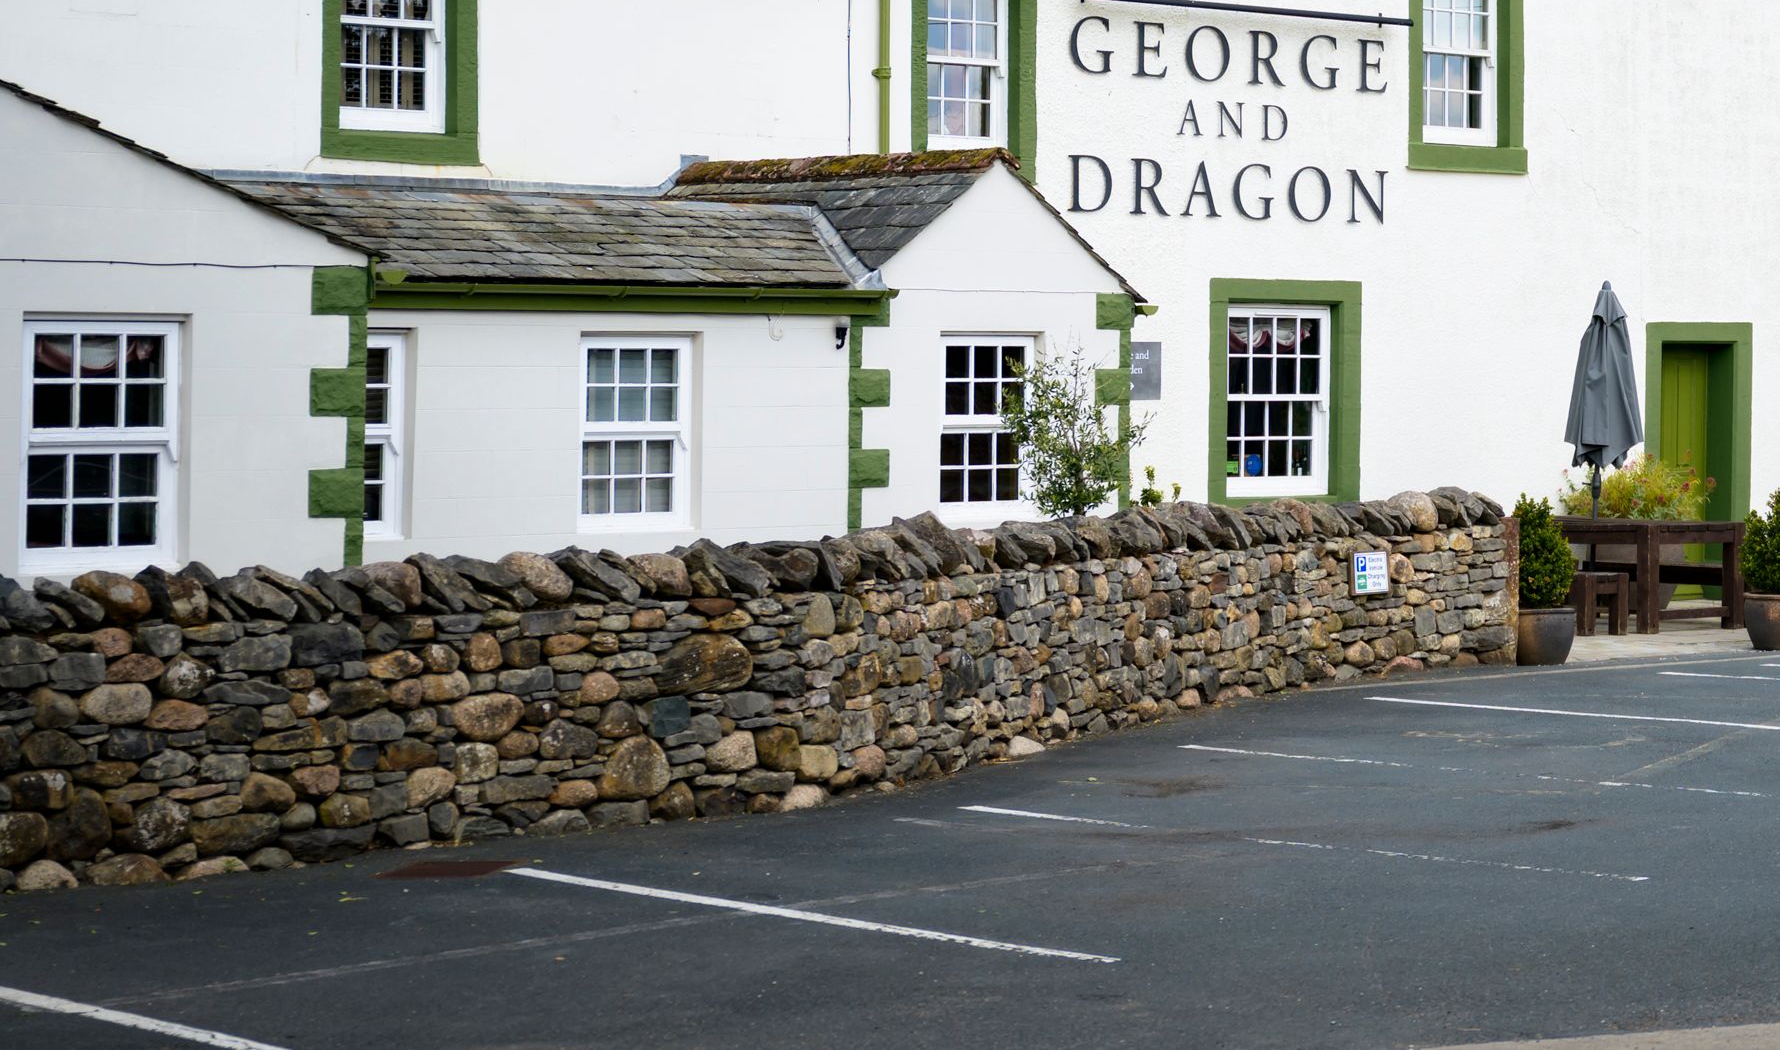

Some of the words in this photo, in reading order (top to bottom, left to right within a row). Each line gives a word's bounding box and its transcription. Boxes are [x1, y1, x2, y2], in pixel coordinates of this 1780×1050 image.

[1070, 15, 1389, 94] GEORGE
[1176, 99, 1289, 142] AND
[1067, 154, 1389, 226] DRAGON
